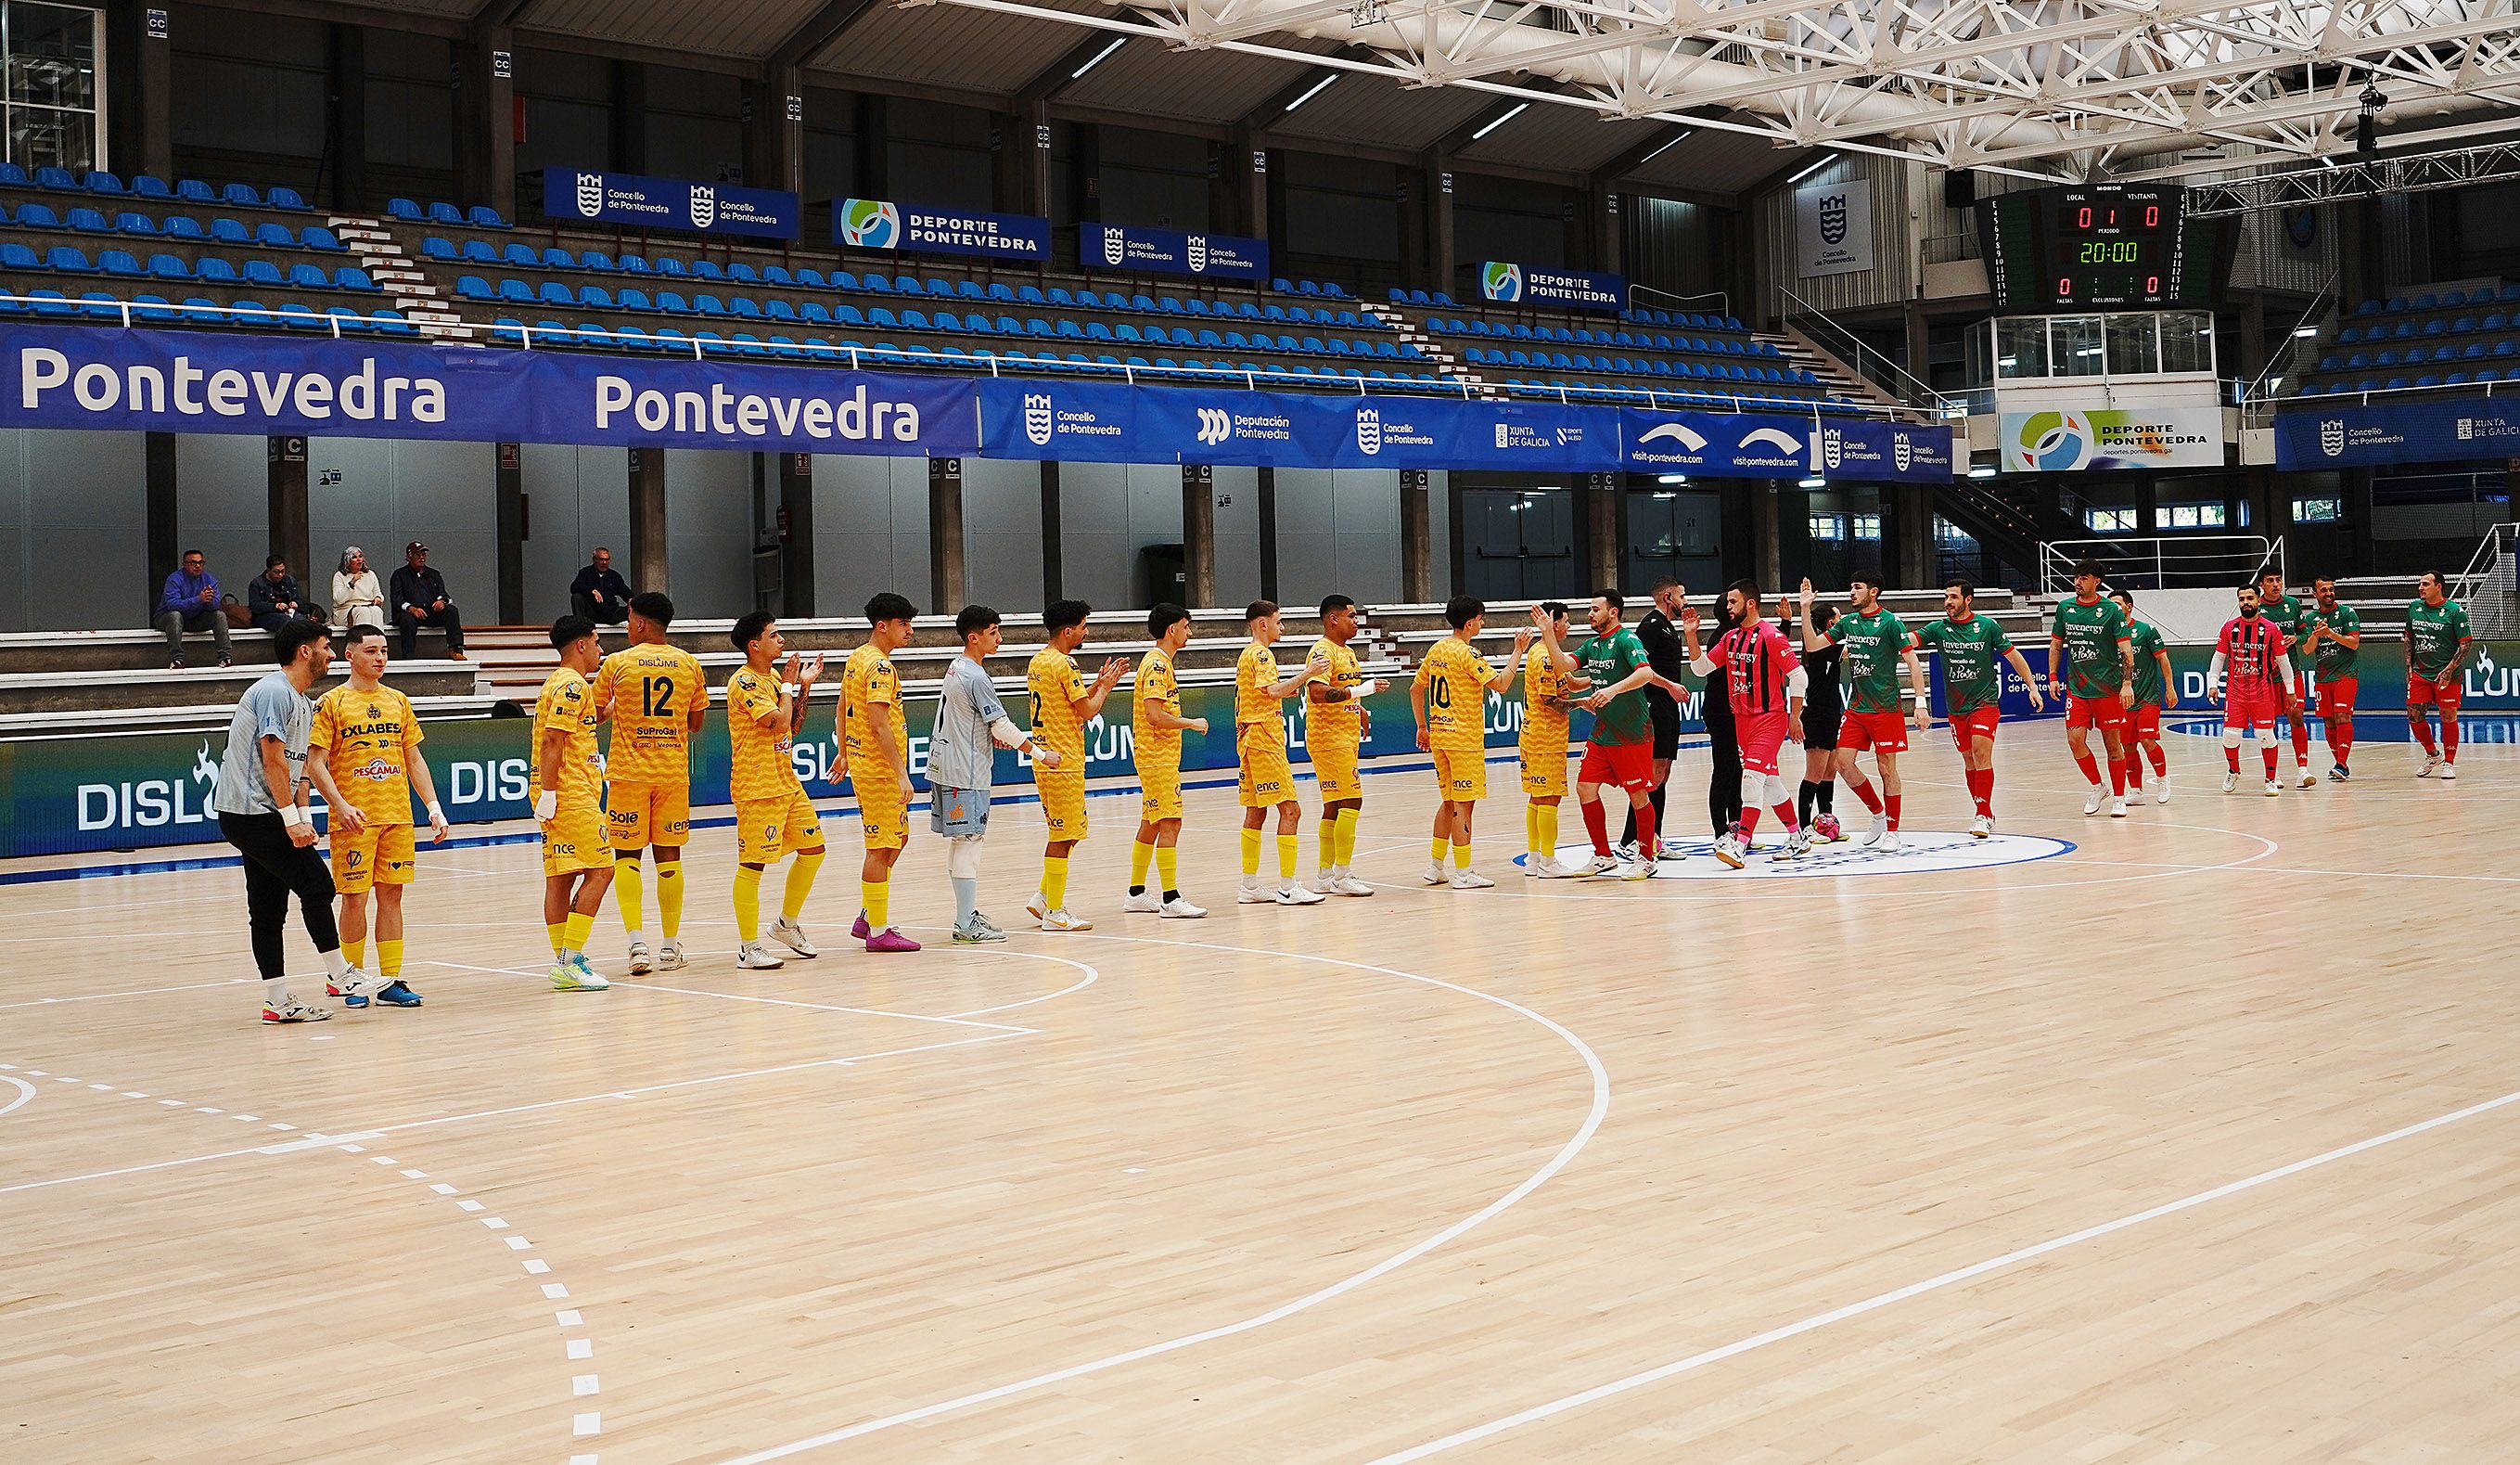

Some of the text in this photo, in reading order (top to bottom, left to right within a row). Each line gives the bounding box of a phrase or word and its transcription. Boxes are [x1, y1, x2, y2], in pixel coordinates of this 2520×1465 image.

[148, 19, 166, 29] CC
[495, 59, 509, 69] CC
[608, 188, 646, 201] Concello
[608, 200, 670, 214] de Pontevedra
[720, 200, 755, 212] Concello
[720, 212, 777, 225] de Pontevedra
[2079, 207, 2091, 228] 0
[2110, 210, 2115, 224] 1
[2145, 206, 2158, 226] 0
[910, 214, 998, 233] DEPORTE
[911, 230, 1038, 251] PONTEVEDRA
[1127, 240, 1155, 251] Concello
[1127, 250, 1173, 261] de Pontevedra
[1209, 248, 1236, 258] Concello
[1822, 249, 1848, 258] Concello
[2080, 242, 2137, 263] 20:00
[1219, 258, 1253, 268] Pontevedra
[1823, 256, 1856, 265] Pontevedra
[2171, 267, 2181, 276] 12
[1530, 274, 1590, 289] DEPORTE
[2059, 278, 2071, 295] 0
[2147, 276, 2158, 293] 0
[1530, 286, 1617, 303] PONTEVEDRA
[20, 347, 446, 423] Pontevedra
[595, 375, 919, 442] Pontevedra
[1056, 410, 1096, 422] Concello
[1234, 415, 1290, 431] Deputación
[1383, 423, 1414, 433] Concello
[2102, 424, 2174, 434] DEPORTE
[2475, 418, 2506, 428] XUNTA
[1057, 423, 1121, 436] de Pontevedra
[1235, 427, 1289, 441] Pontevedra
[1509, 426, 1535, 436] XUNTA
[2348, 427, 2383, 437] Concello
[2475, 426, 2520, 437] DE GALICI
[288, 438, 301, 453] C
[1384, 434, 1434, 445] de Pontevedra
[1509, 437, 1551, 447] DE GALICIA
[1843, 441, 1867, 450] Concello
[2103, 435, 2207, 446] PONTEVEDRA
[2360, 434, 2404, 445] Pontevedra
[1631, 451, 1703, 464] visit-pontevedra.com
[1843, 451, 1881, 460] de Pontevedra
[2103, 447, 2173, 456] deportes.pontevedra.gal
[948, 459, 958, 472] C
[1733, 456, 1798, 468] visit-pontevedra.com
[1200, 465, 1209, 477] C
[1417, 472, 1426, 484] C
[1605, 474, 1612, 484] C
[1770, 478, 1776, 488] C
[2065, 623, 2104, 635] Invenergy
[1942, 639, 1986, 651] Invenergy
[638, 657, 678, 668] DISLUME
[2007, 673, 2047, 683] Conello
[1429, 675, 1451, 709] 10
[2008, 683, 2021, 692] de
[643, 675, 674, 717] 12
[636, 726, 677, 736] SuProGal
[1257, 781, 1280, 791] ence
[554, 843, 576, 855] nce
